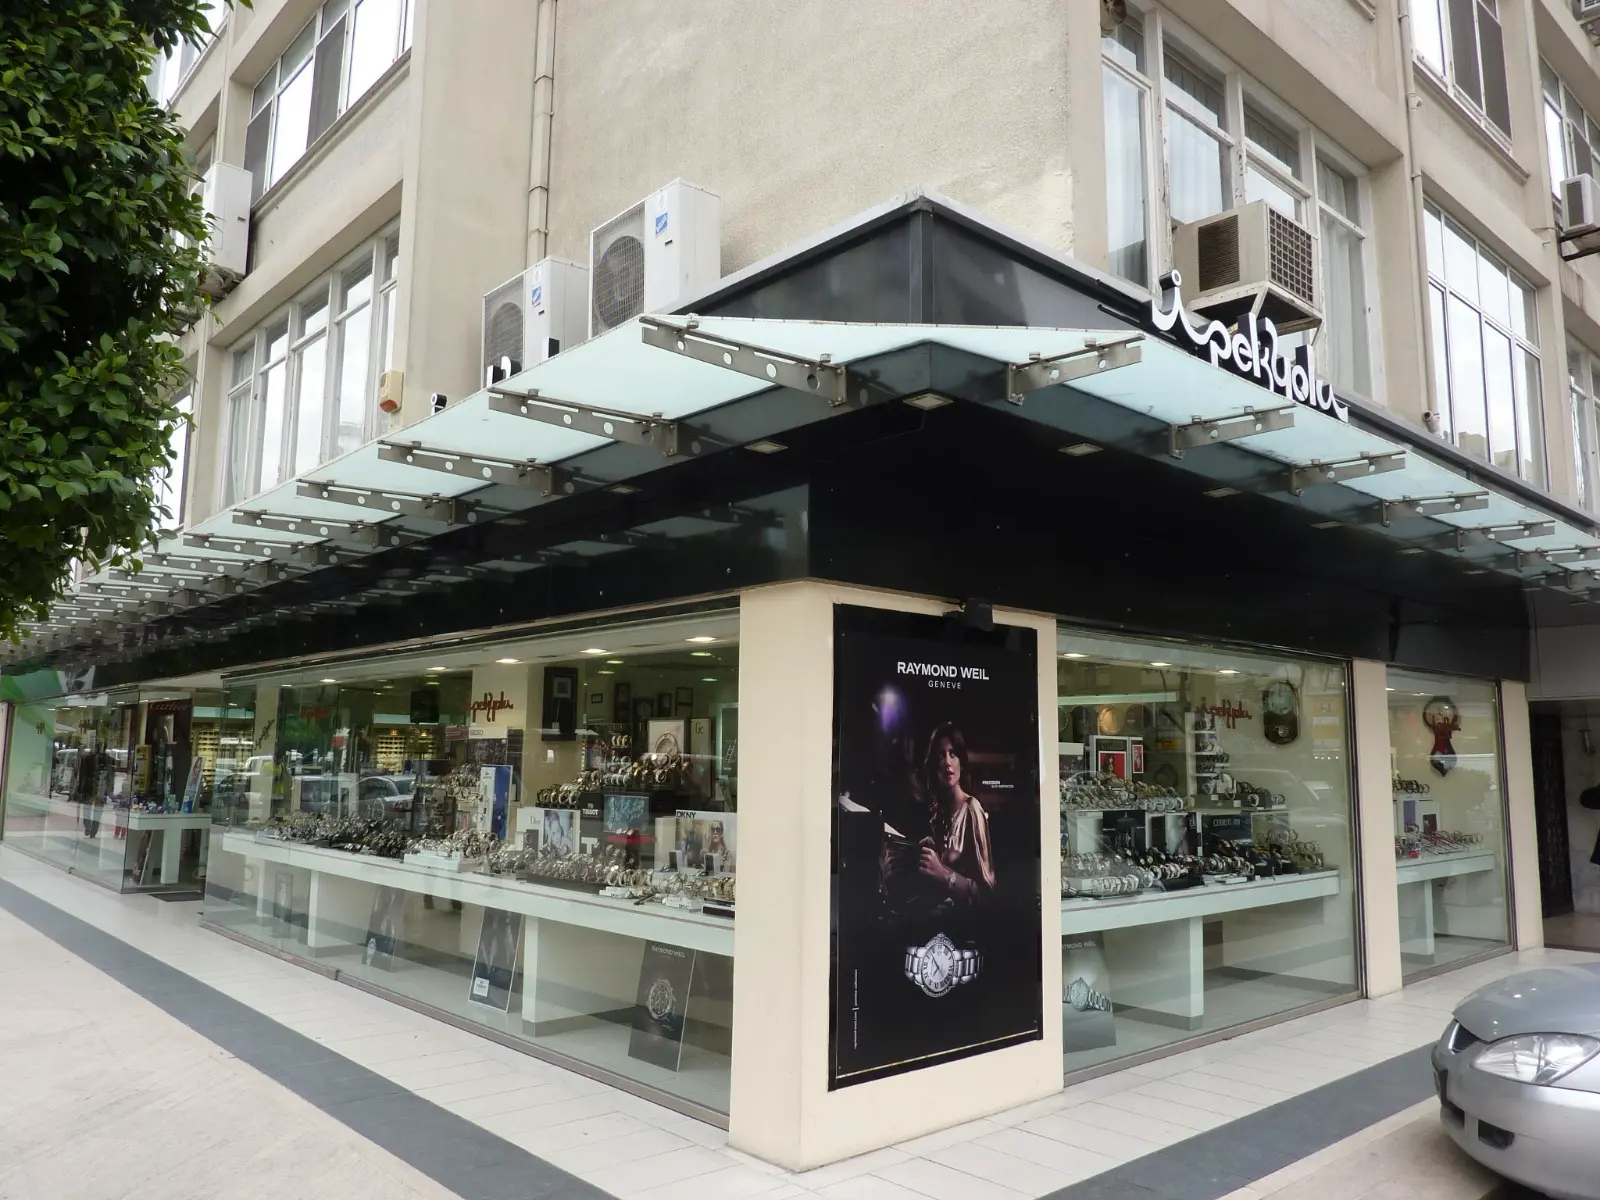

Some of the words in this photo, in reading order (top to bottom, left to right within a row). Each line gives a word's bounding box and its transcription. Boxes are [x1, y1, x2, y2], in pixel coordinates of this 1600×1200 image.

[897, 661, 958, 678] RAYMOND
[960, 666, 990, 680] WEIL
[928, 680, 962, 689] GENEVE
[676, 810, 697, 820] DKNY
